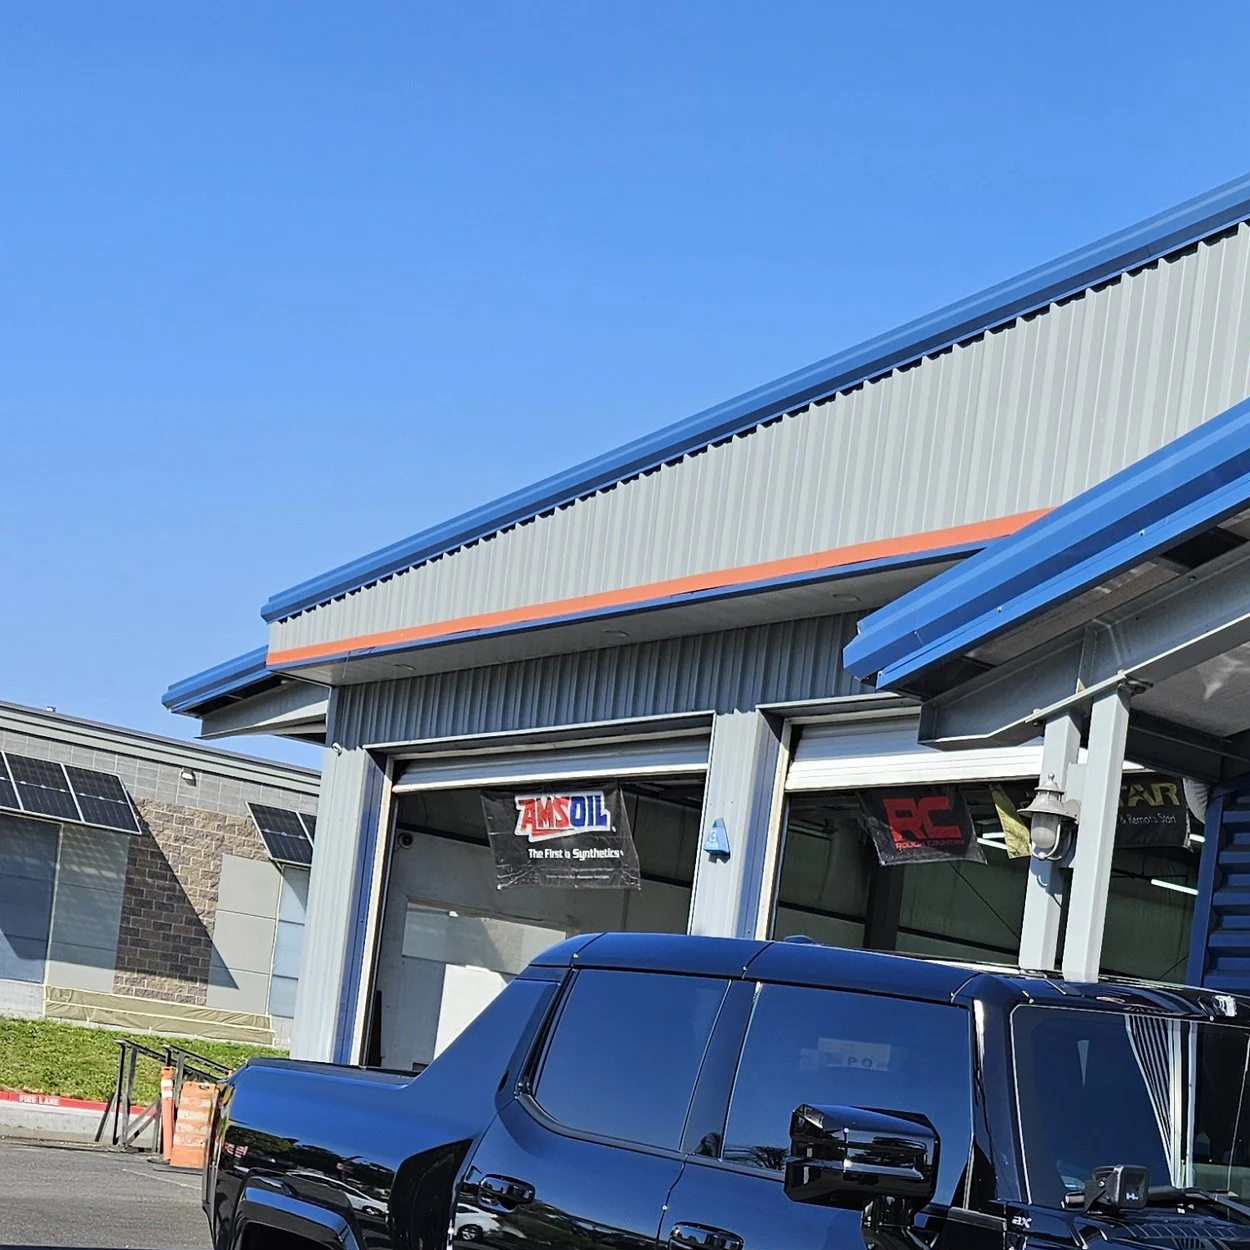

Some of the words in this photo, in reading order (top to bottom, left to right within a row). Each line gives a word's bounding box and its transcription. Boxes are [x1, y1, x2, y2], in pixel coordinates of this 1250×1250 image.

[516, 793, 609, 838] AMSOIL
[883, 796, 962, 842] RC
[528, 849, 544, 858] The
[545, 849, 563, 858] First
[572, 848, 620, 861] Synthetics
[39, 1094, 60, 1107] LANE
